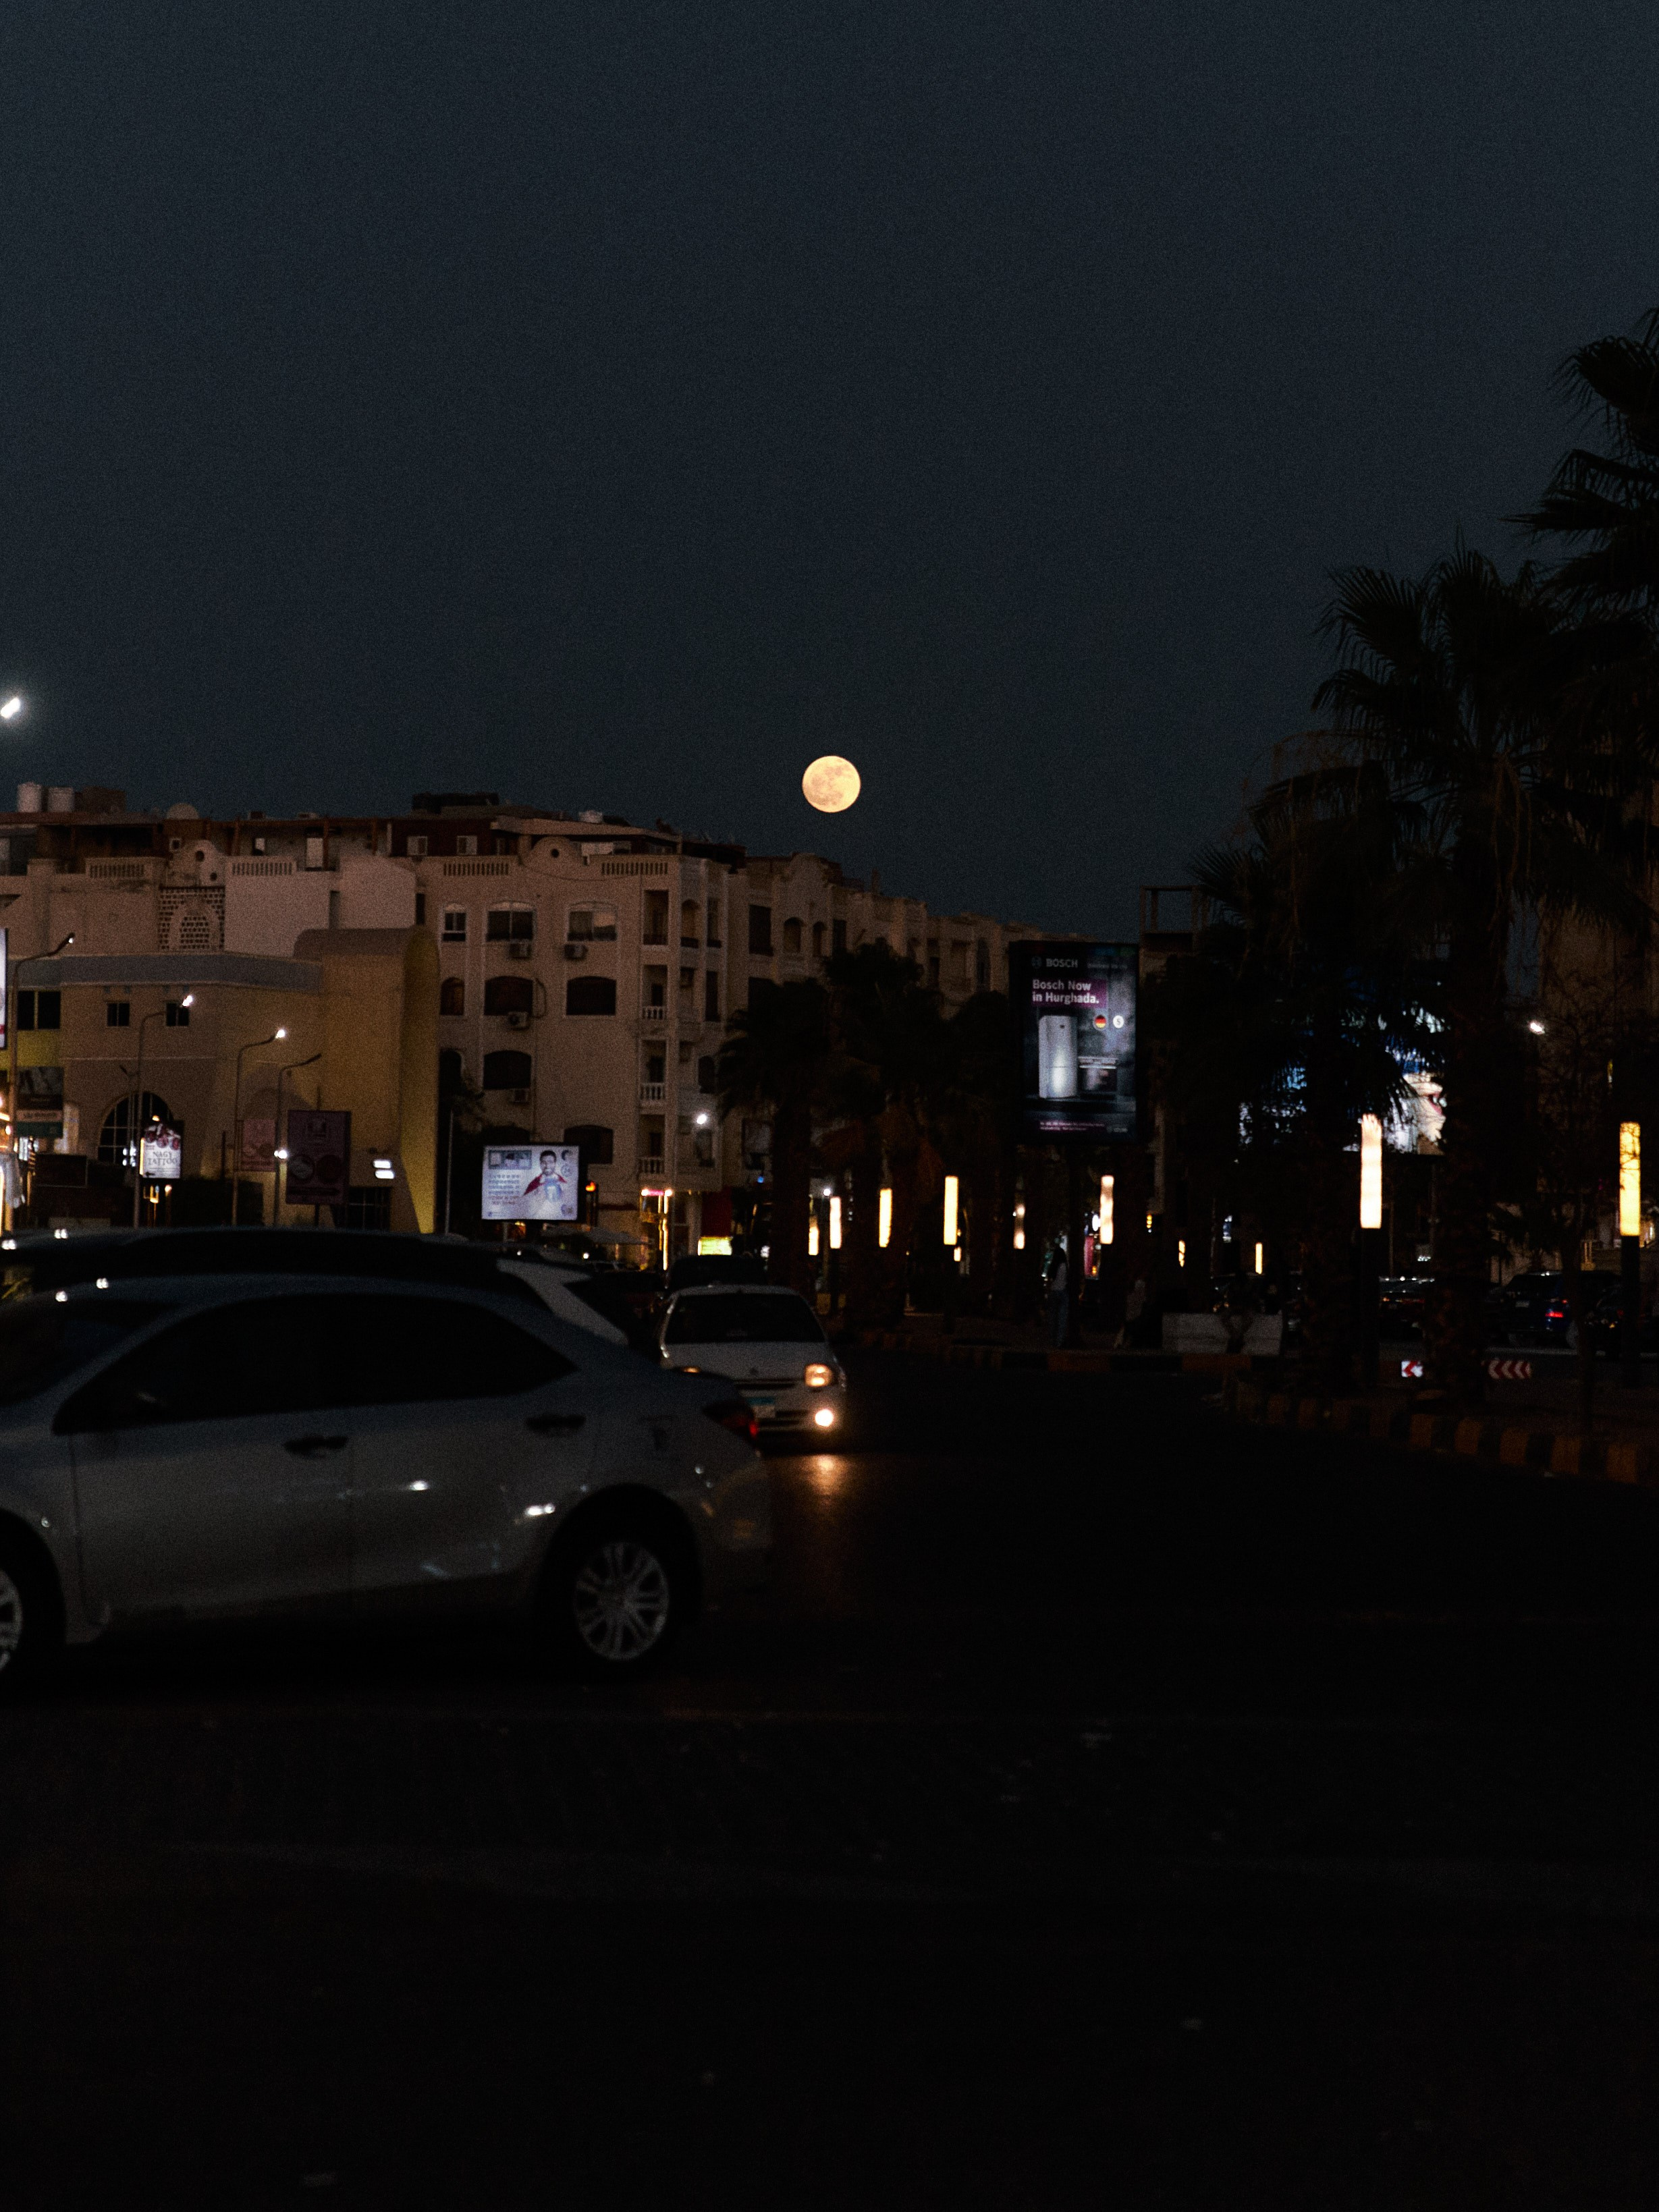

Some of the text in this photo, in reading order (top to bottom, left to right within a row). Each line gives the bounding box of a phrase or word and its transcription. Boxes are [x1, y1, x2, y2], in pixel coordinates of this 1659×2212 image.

[1046, 958, 1079, 968] BOSCH
[1032, 979, 1091, 991] Bosch Now
[1032, 991, 1099, 1005] in Hurghada.
